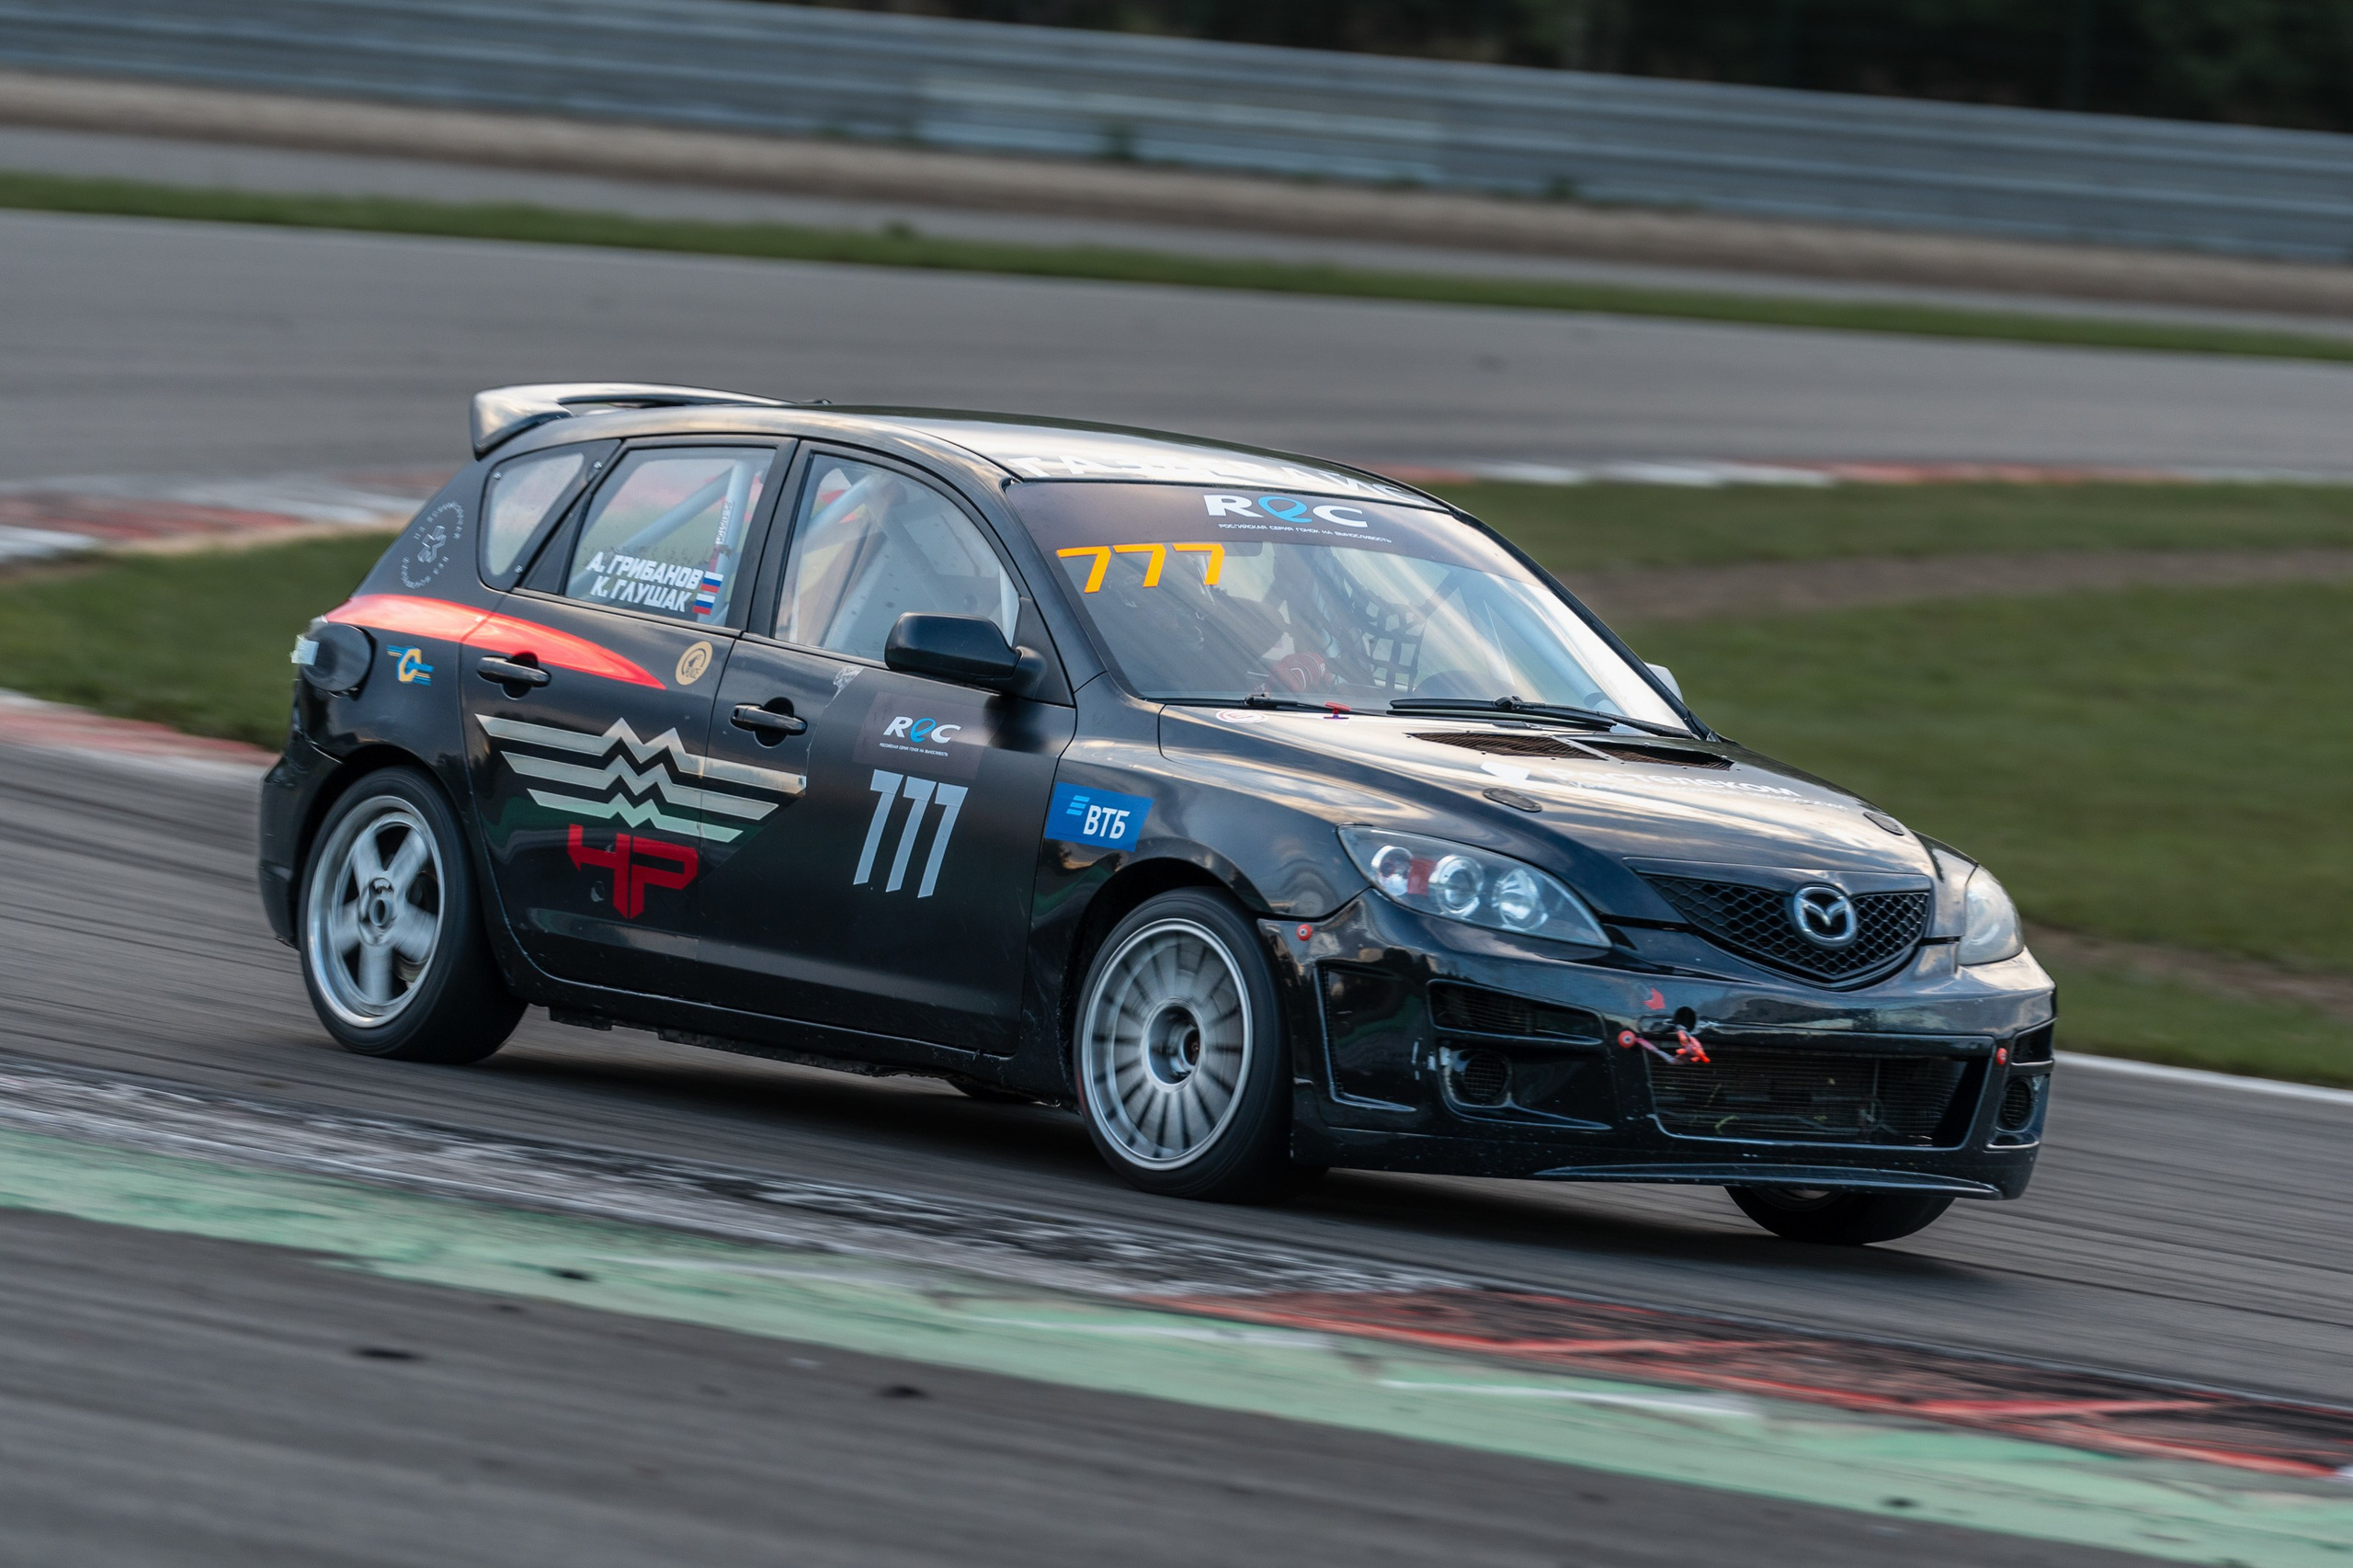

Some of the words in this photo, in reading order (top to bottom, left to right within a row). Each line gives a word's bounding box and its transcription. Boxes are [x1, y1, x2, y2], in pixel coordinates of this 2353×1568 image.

[1056, 542, 1225, 593] 777
[853, 768, 970, 899] 777
[1083, 804, 1131, 839] ВТБ
